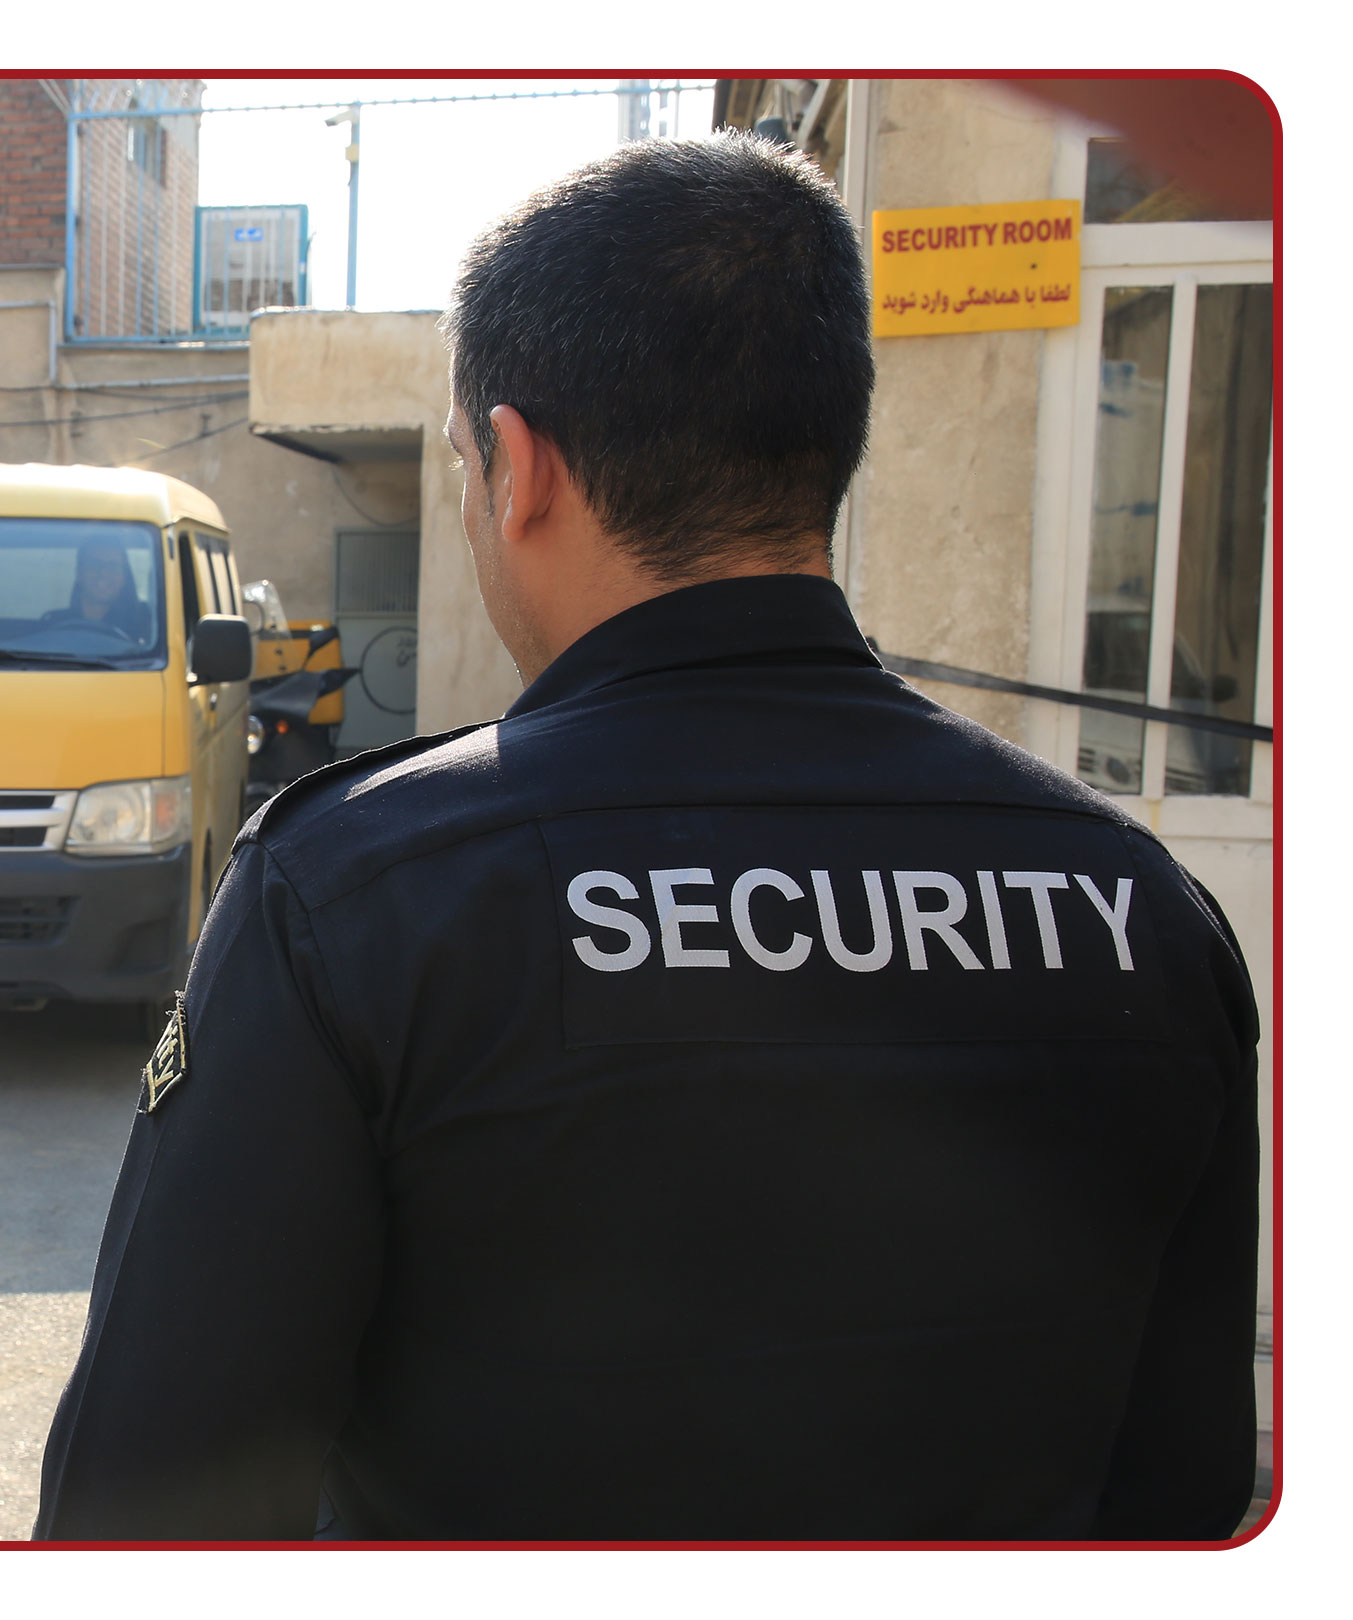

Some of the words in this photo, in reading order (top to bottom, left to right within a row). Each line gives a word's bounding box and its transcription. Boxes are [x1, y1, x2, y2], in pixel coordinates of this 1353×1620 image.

[881, 223, 998, 254] SECURITY
[1002, 217, 1073, 246] ROOM
[882, 291, 917, 315] شوید
[920, 289, 950, 315] وارد
[953, 286, 1021, 314] هماهنگی
[1024, 286, 1037, 309] با
[1040, 283, 1072, 303] لطفا
[566, 867, 1135, 973] SECURITY
